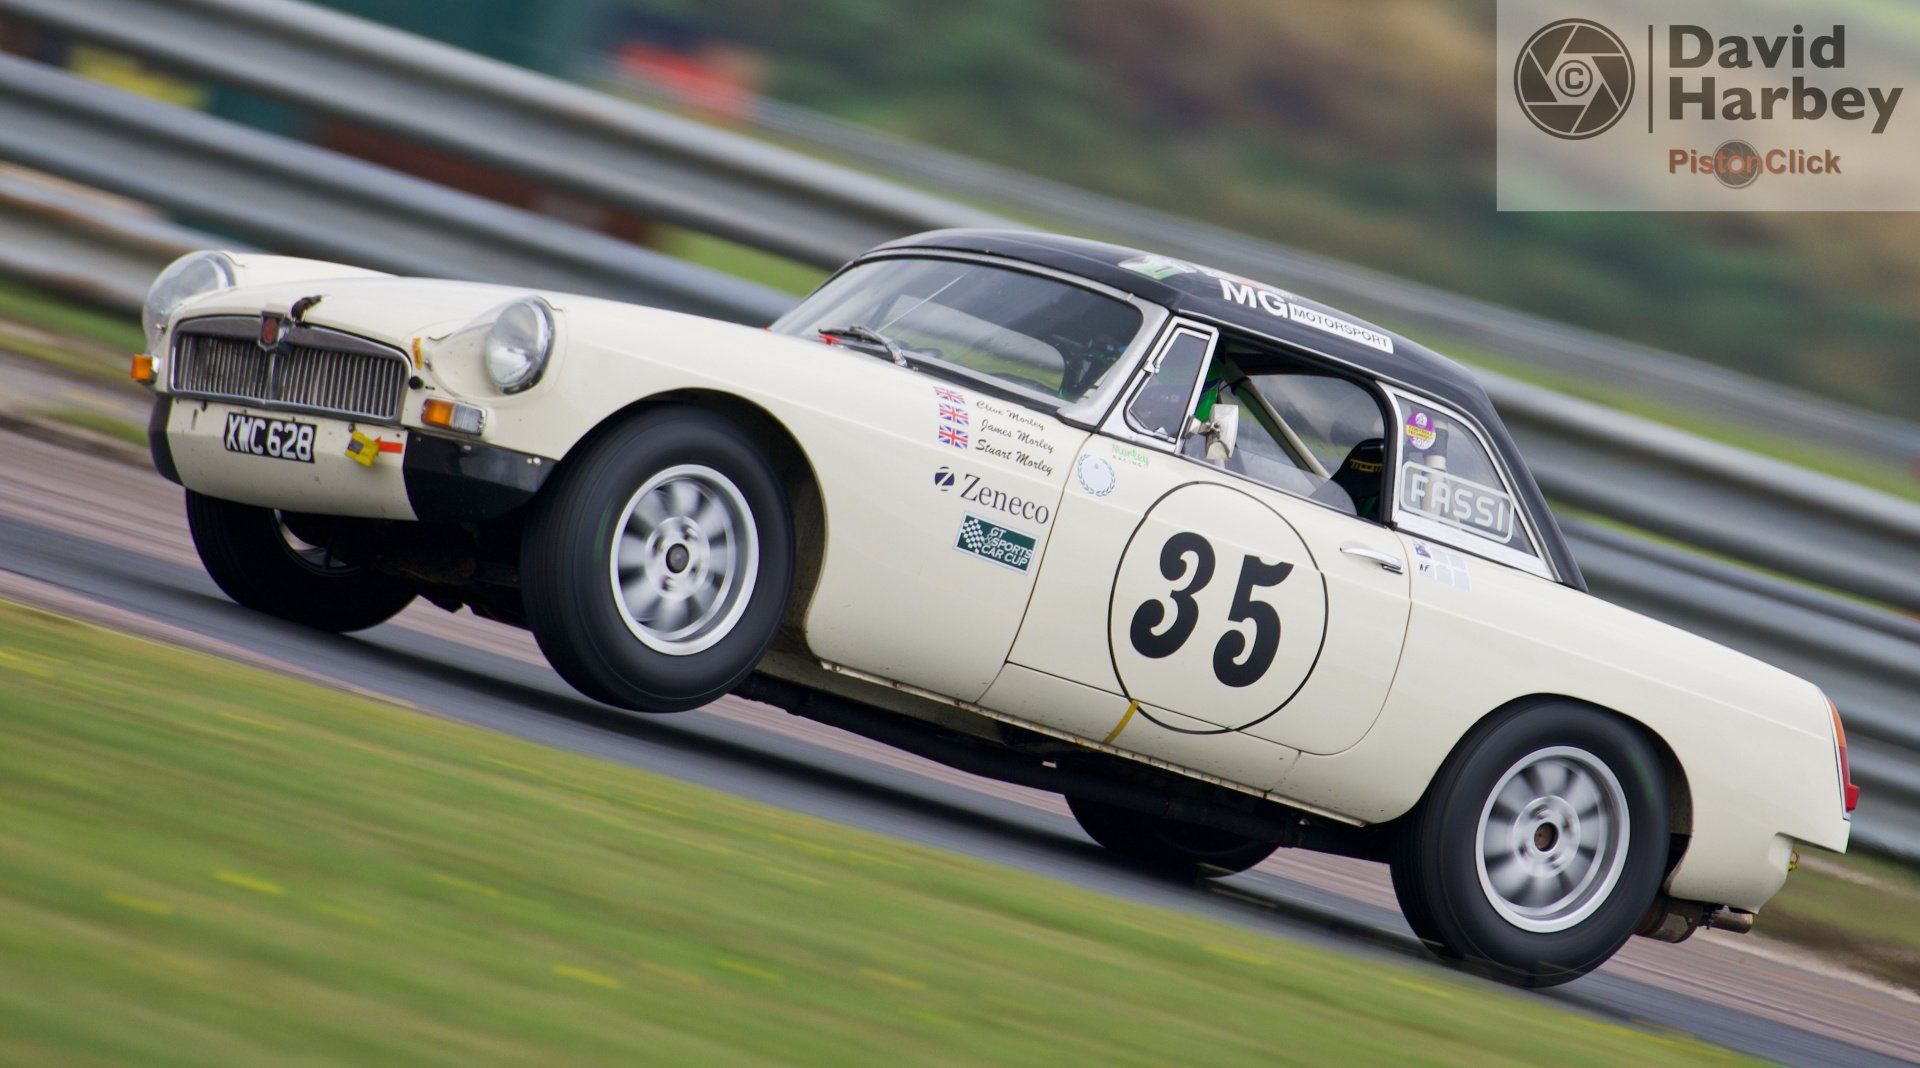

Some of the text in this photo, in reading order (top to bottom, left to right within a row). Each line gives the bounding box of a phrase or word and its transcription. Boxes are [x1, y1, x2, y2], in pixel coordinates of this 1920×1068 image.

[1219, 278, 1388, 348] MG MOTORSPORT
[980, 418, 1054, 454] James Morley
[1006, 409, 1044, 432] Morley
[266, 420, 314, 462] 628
[975, 438, 1053, 476] Stuart Morley
[960, 473, 1050, 525] Zeneco
[1410, 473, 1505, 532] FASSI
[990, 526, 1007, 538] GT
[991, 537, 1033, 559] SPORTS
[981, 544, 1028, 566] CAR CUP
[1129, 531, 1295, 688] 35
